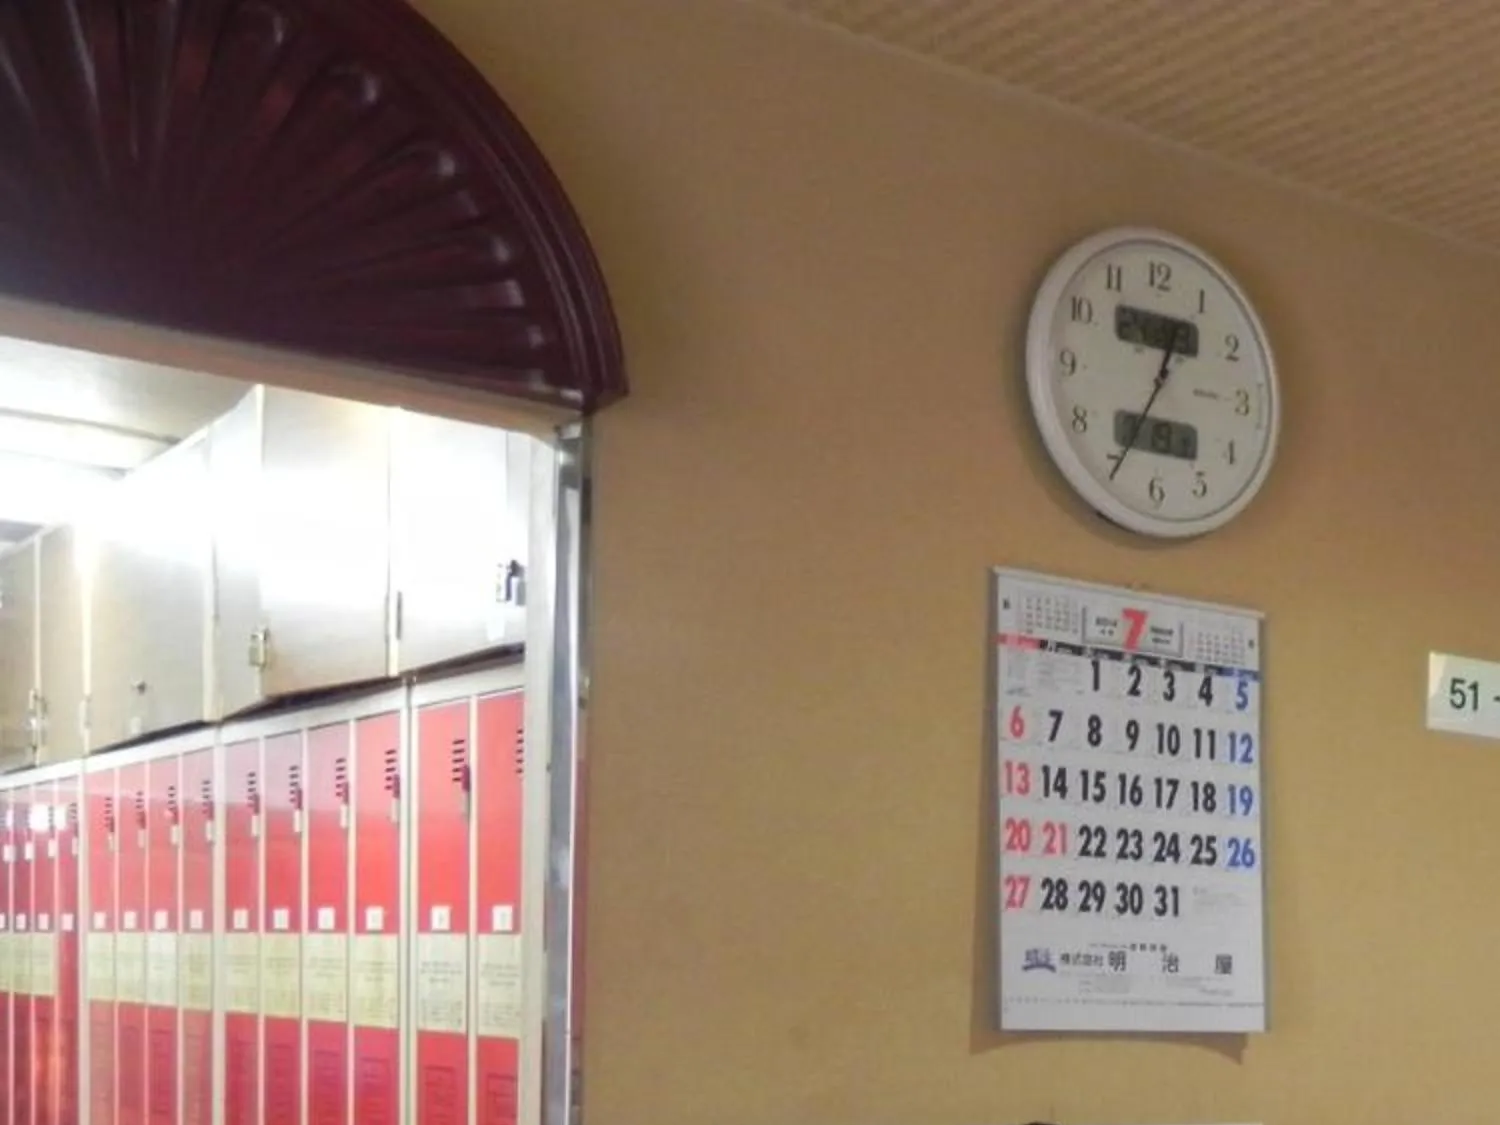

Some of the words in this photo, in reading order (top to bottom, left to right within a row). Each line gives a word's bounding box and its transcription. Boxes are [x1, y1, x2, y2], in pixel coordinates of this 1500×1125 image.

[1105, 264, 1122, 292] 11
[1149, 262, 1171, 291] 12
[1070, 296, 1093, 323] 10
[1198, 289, 1206, 314] 1
[1224, 334, 1240, 362] 2
[1060, 351, 1077, 376] 9
[1235, 389, 1250, 417] 3
[1072, 406, 1088, 433] 8
[1148, 476, 1166, 503] 6
[1193, 471, 1207, 498] 5
[1122, 608, 1148, 650] 7
[1091, 660, 1100, 692] 1
[1127, 665, 1142, 697] 2
[1163, 670, 1176, 702] 3
[1198, 676, 1214, 706] 4
[1235, 680, 1249, 711] 5
[1010, 706, 1025, 738] 6
[1049, 710, 1063, 742] 7
[1088, 715, 1102, 747] 8
[1126, 720, 1140, 751] 9
[1157, 723, 1181, 756] 10
[1194, 728, 1216, 760] 11
[1229, 732, 1254, 763] 12
[1005, 761, 1030, 795] 13
[1042, 765, 1067, 800] 14
[1081, 769, 1106, 803] 15
[1119, 773, 1143, 806] 16
[1155, 778, 1180, 809] 17
[1191, 781, 1216, 813] 18
[1228, 785, 1254, 815] 19
[1005, 818, 1031, 852] 20
[1043, 821, 1068, 855] 21
[1078, 825, 1107, 858] 22
[1116, 828, 1143, 860] 23
[1153, 831, 1180, 863] 24
[1191, 834, 1217, 866] 25
[1228, 838, 1255, 868] 26
[1005, 876, 1030, 909] 27
[1041, 877, 1068, 910] 28
[1078, 880, 1106, 913] 29
[1115, 883, 1143, 915] 30
[1154, 885, 1179, 917] 31
